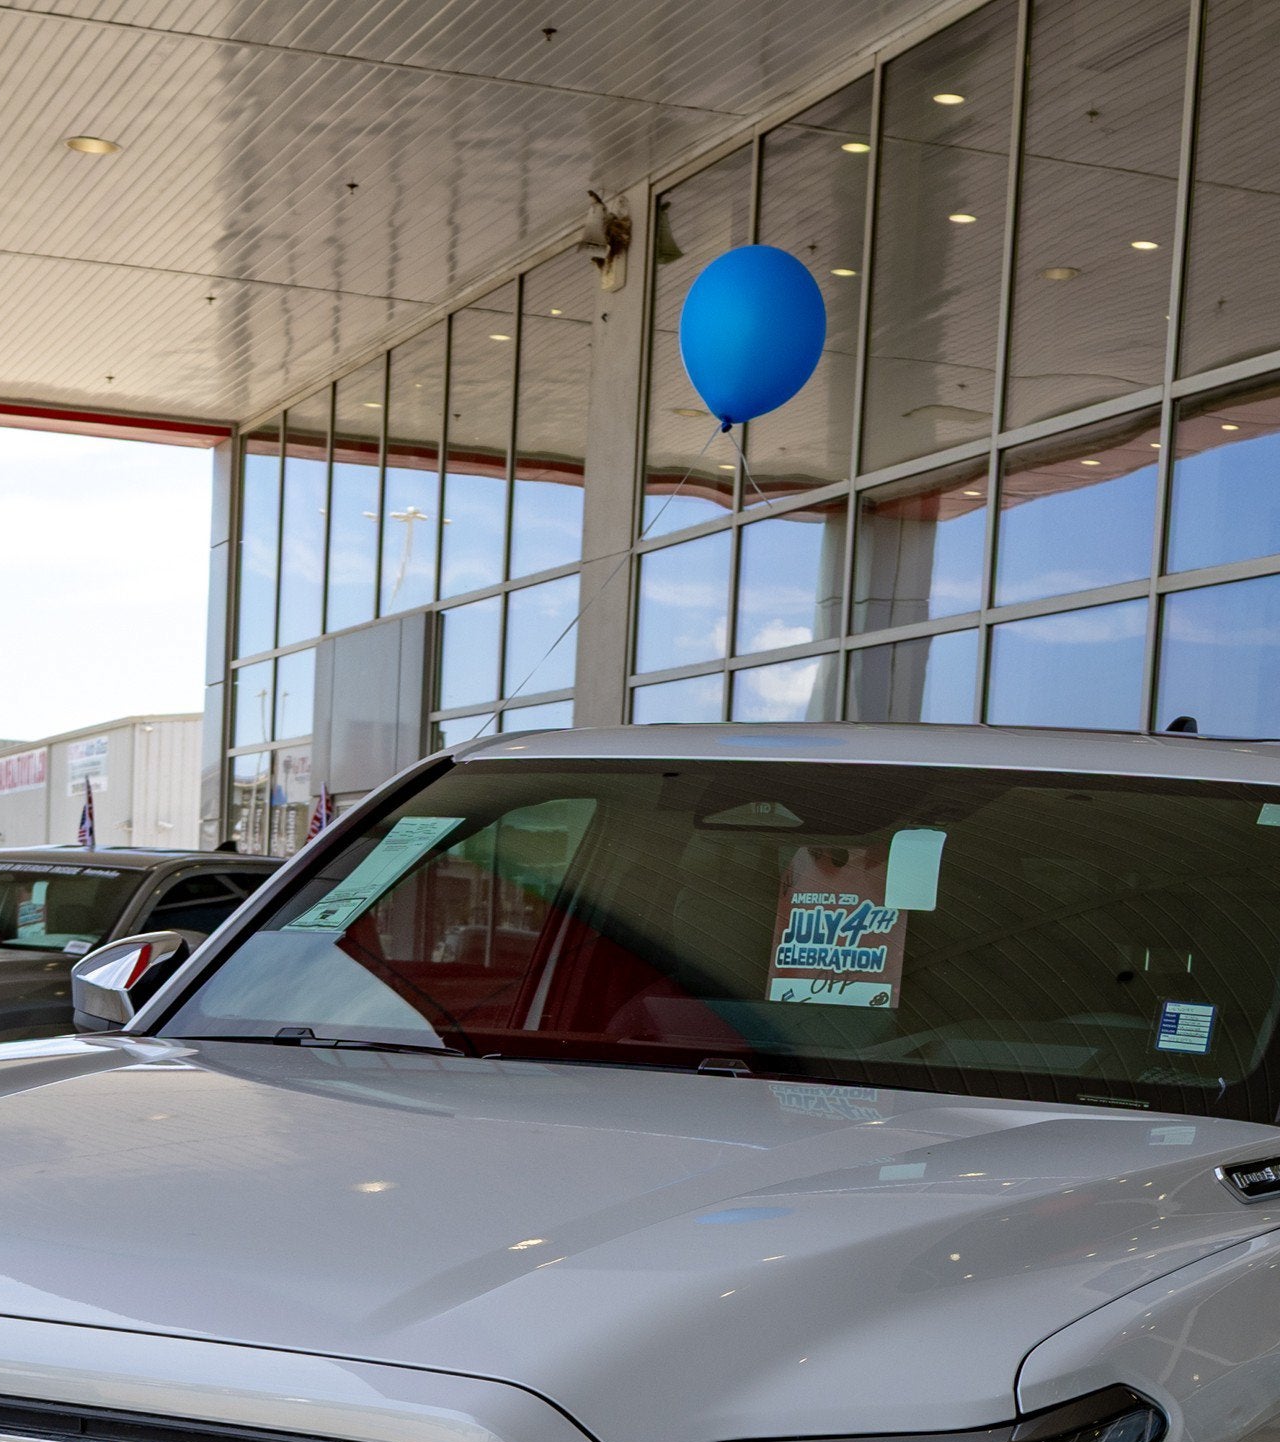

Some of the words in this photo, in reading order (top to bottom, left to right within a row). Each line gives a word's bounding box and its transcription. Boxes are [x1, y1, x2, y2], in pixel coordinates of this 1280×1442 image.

[791, 893, 837, 905] AMERICA
[783, 907, 846, 946] JULY
[839, 901, 898, 947] 4TH
[776, 944, 887, 972] CELEBRATION
